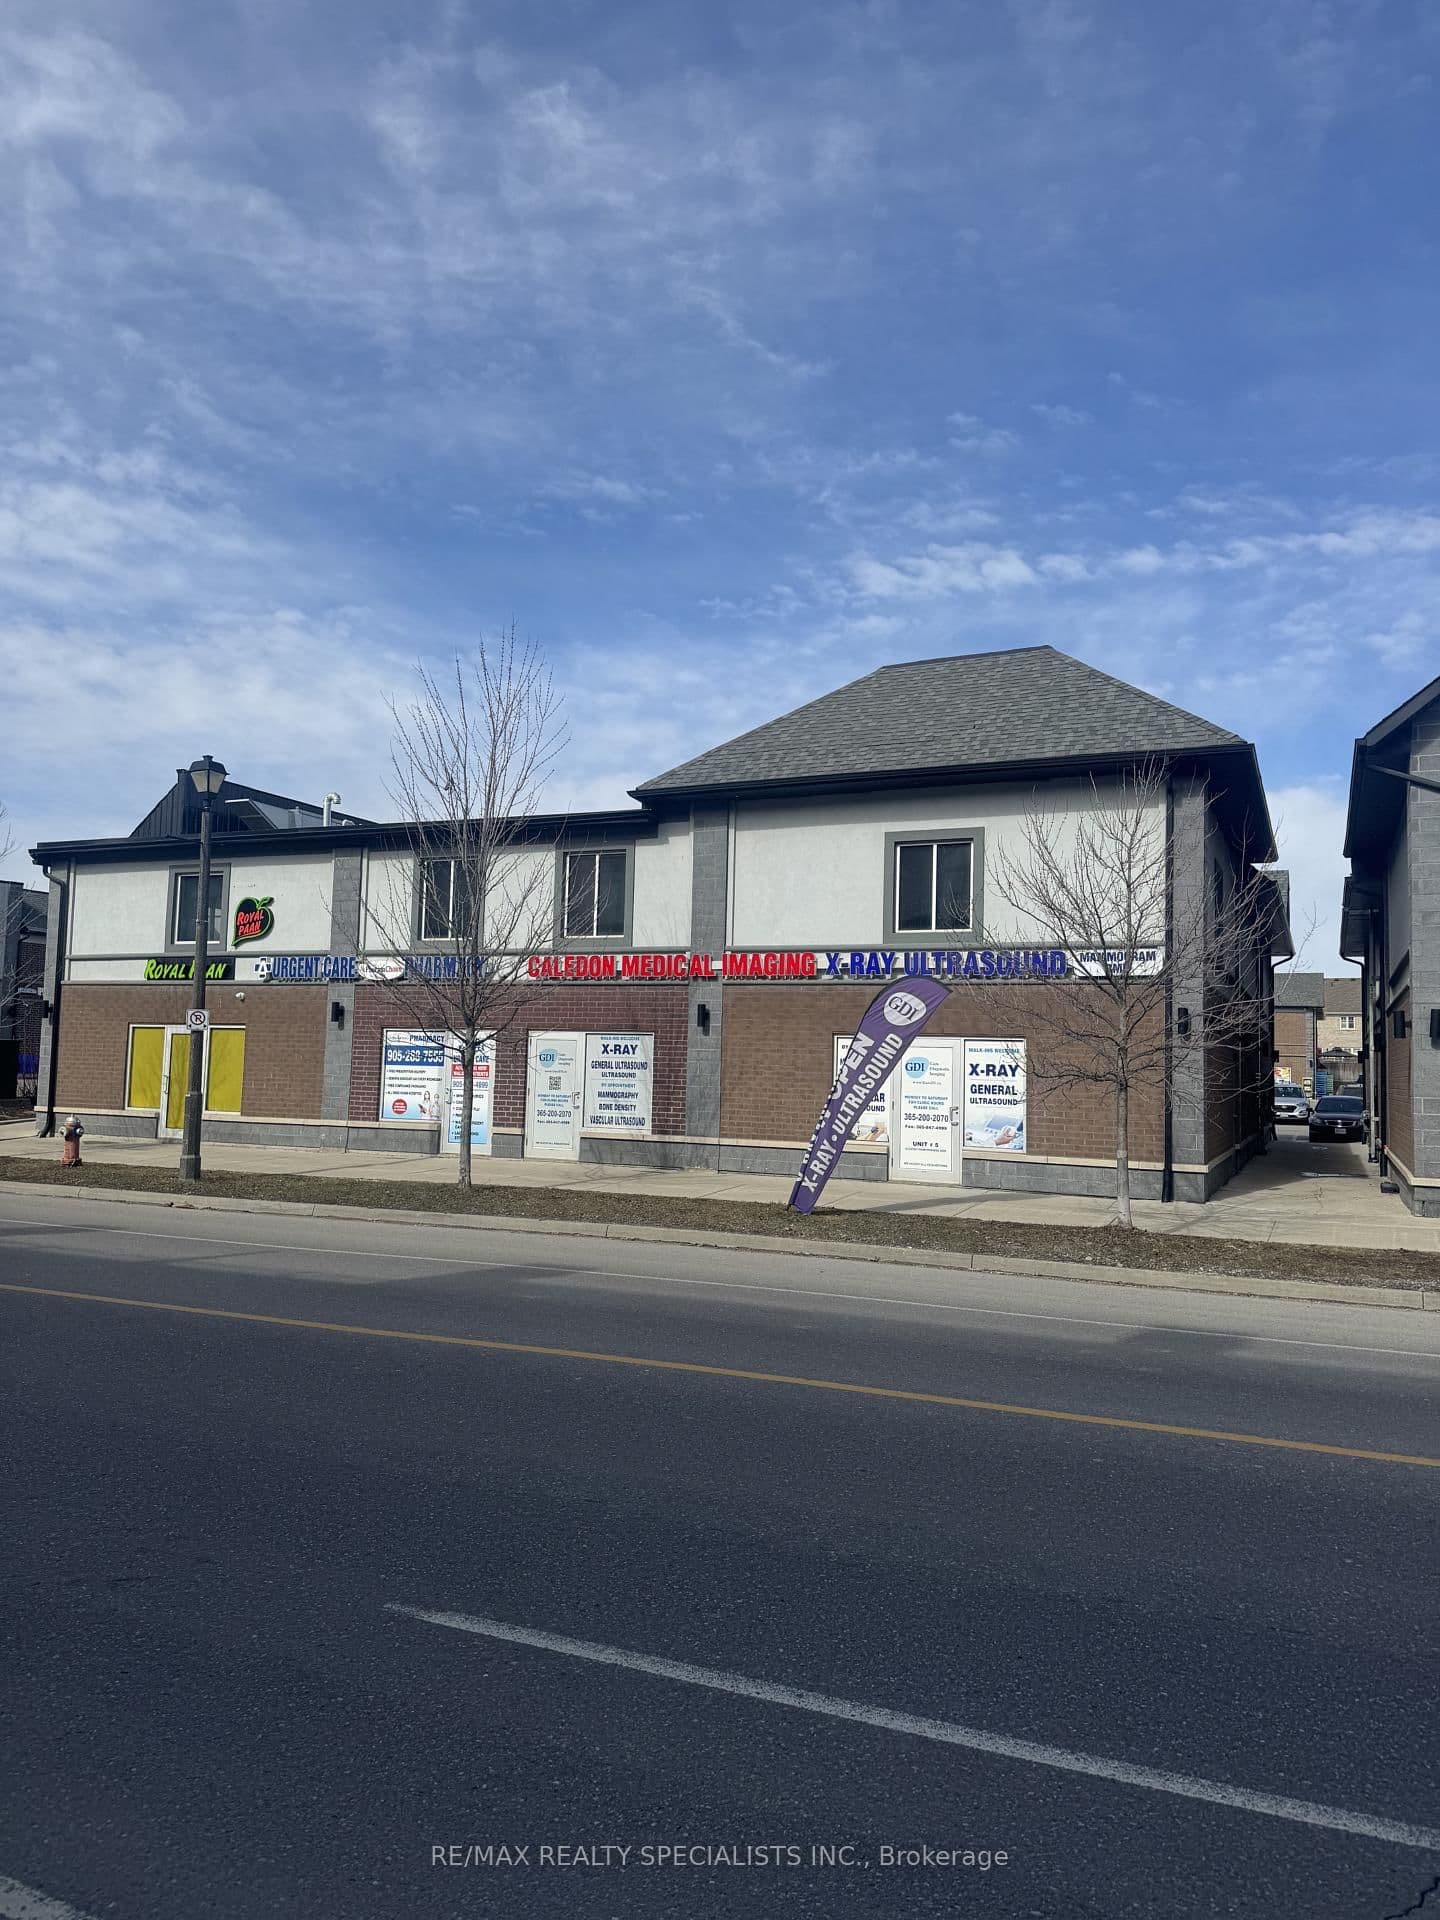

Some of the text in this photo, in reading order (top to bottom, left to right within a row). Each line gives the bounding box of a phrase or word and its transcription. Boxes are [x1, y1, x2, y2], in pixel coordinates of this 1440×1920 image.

[237, 909, 265, 926] ROYAL
[238, 920, 261, 936] PAAN
[144, 959, 186, 980] ROYAL
[272, 956, 357, 979] URGENT CARE
[528, 952, 816, 978] CALEDON MEDICAL IMAGING
[826, 951, 1067, 977] X-RAY ULTRASOUND
[887, 995, 920, 1022] GDI
[601, 1043, 638, 1055] X-RAY
[539, 1053, 555, 1062] GDI
[591, 1060, 648, 1071] GENERAL ULTRASOUND
[904, 1062, 926, 1072] GDI
[969, 1063, 1018, 1077] X-RAY
[601, 1071, 637, 1079] ULTRASOUND
[970, 1084, 1018, 1095] GENERAL
[969, 1097, 1018, 1106] ULTRASOUND
[614, 1104, 637, 1112] DENSITY
[801, 1138, 837, 1194] X-RAY
[831, 1033, 903, 1136] ULTRASOUND
[614, 1116, 646, 1127] ULTRASOUND
[904, 1112, 949, 1123] 365-200-2070
